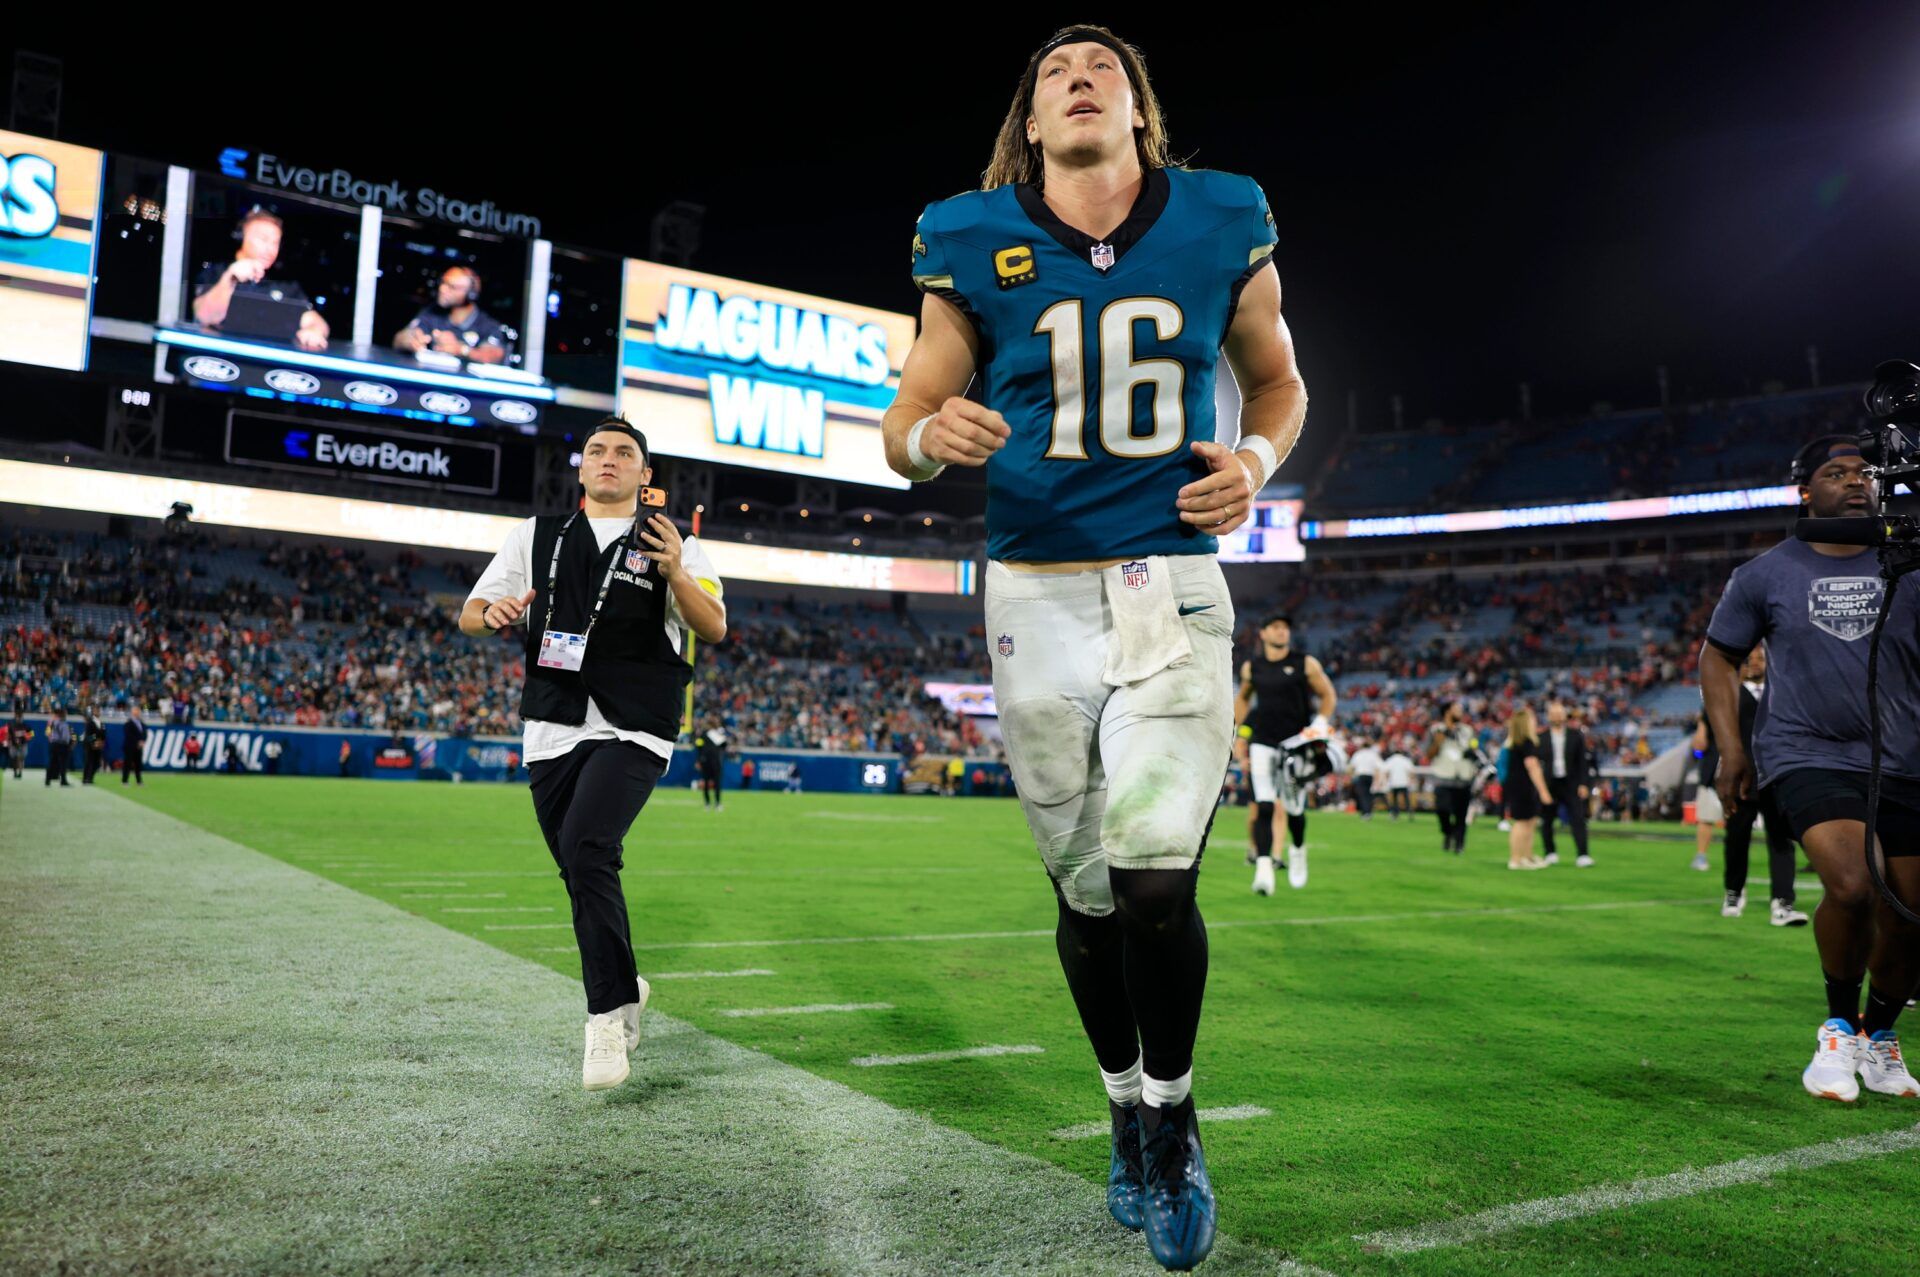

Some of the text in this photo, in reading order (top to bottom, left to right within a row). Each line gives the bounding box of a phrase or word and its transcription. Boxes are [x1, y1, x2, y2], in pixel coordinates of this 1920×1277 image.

[0, 153, 58, 238] S
[255, 152, 542, 237] EverBank Stadium
[995, 246, 1032, 278] C
[653, 283, 890, 387] JAGUARS
[1033, 295, 1187, 462] 16
[707, 370, 825, 459] WIN
[315, 433, 450, 478] EverBank
[613, 571, 634, 584] OCIAL
[1126, 573, 1147, 587] NFL
[1829, 582, 1864, 591] ESPN
[1817, 593, 1877, 602] MONDAY
[1827, 600, 1869, 609] NIGHT
